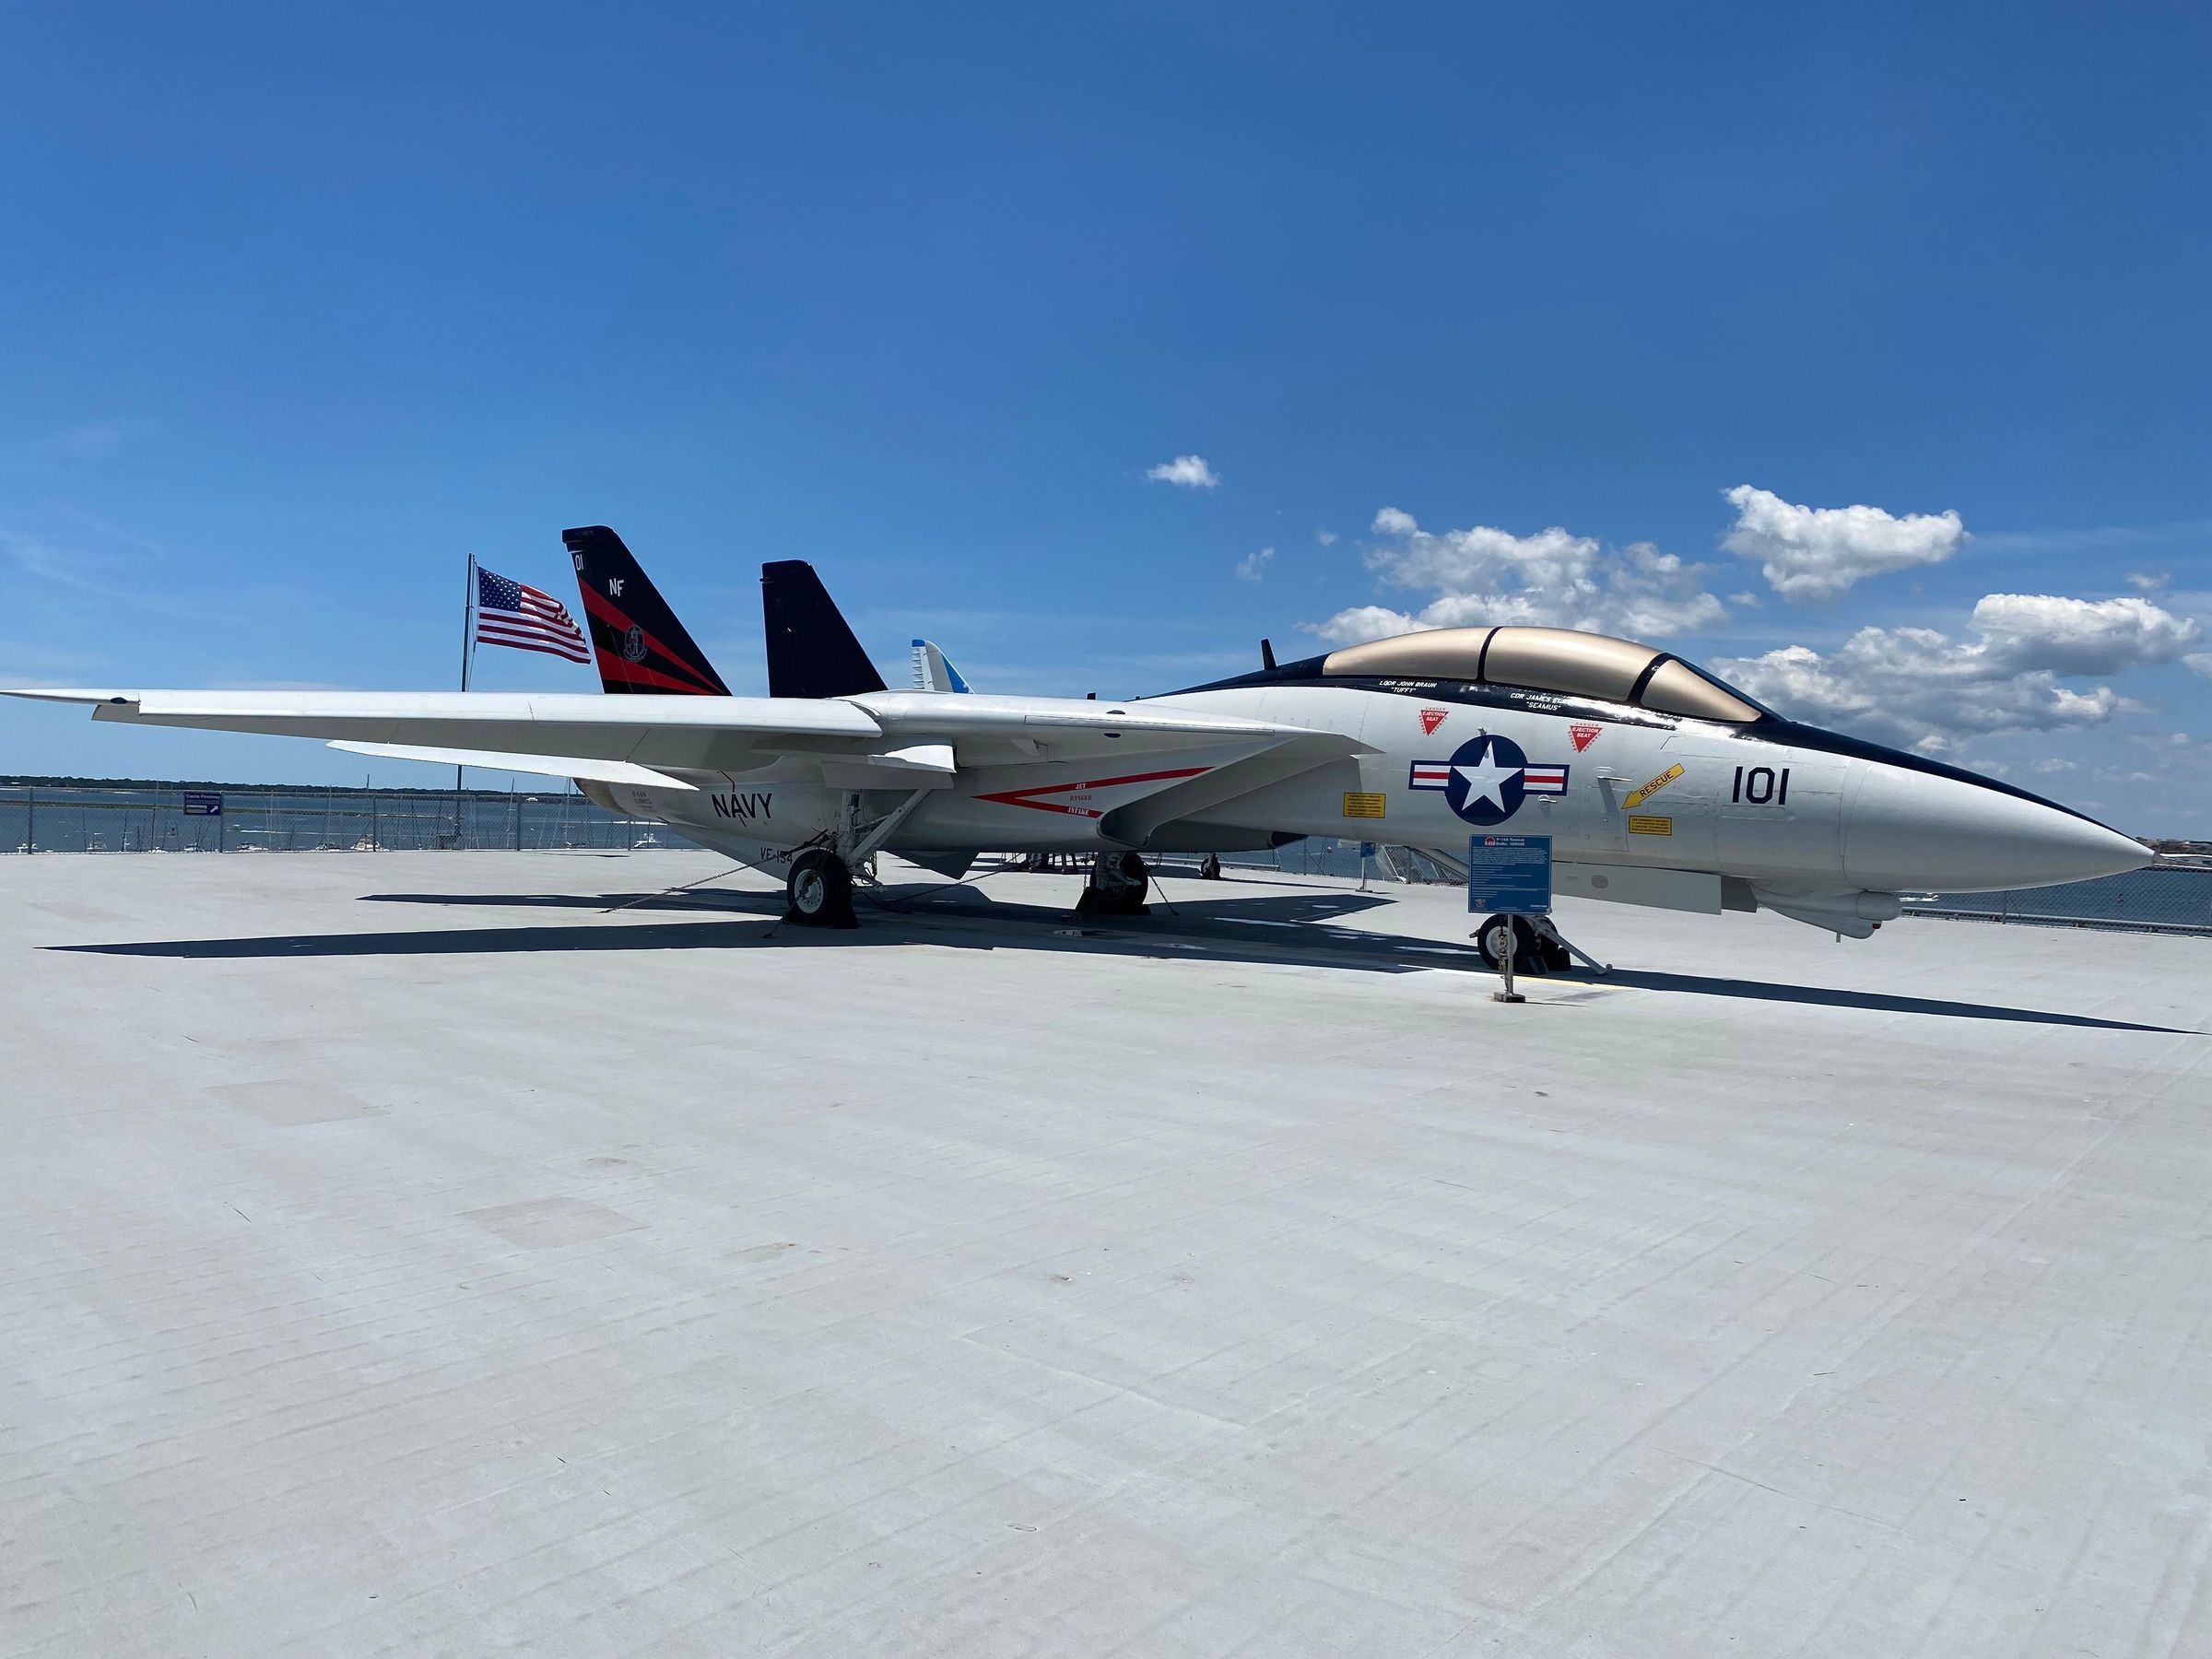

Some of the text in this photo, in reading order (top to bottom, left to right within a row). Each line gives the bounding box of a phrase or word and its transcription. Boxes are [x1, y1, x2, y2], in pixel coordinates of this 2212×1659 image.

[609, 578, 624, 597] NF
[1526, 694, 1551, 703] JAMES
[1526, 701, 1561, 712] "SEAMUS"
[1638, 770, 1675, 798] RESCUE
[1732, 766, 1791, 806] 101
[711, 792, 773, 819] NAVY
[1067, 806, 1090, 816] INTAKE
[760, 846, 793, 865] VF-154
